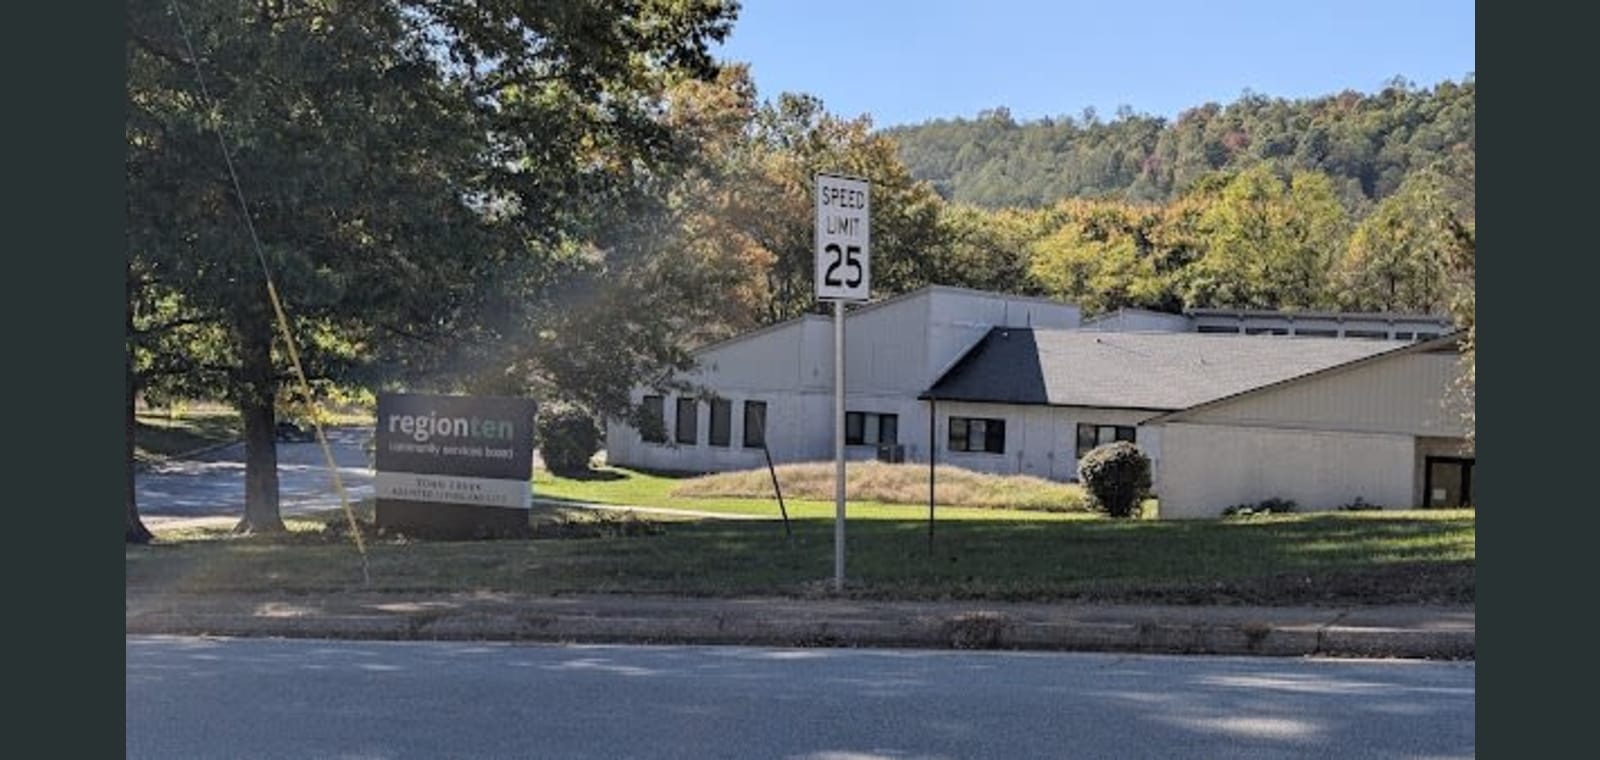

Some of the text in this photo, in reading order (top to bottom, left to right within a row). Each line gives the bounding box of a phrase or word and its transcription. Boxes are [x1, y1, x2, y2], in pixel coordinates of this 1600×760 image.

[822, 186, 865, 210] SPEED
[826, 216, 860, 236] LIMIT
[824, 243, 862, 288] 25
